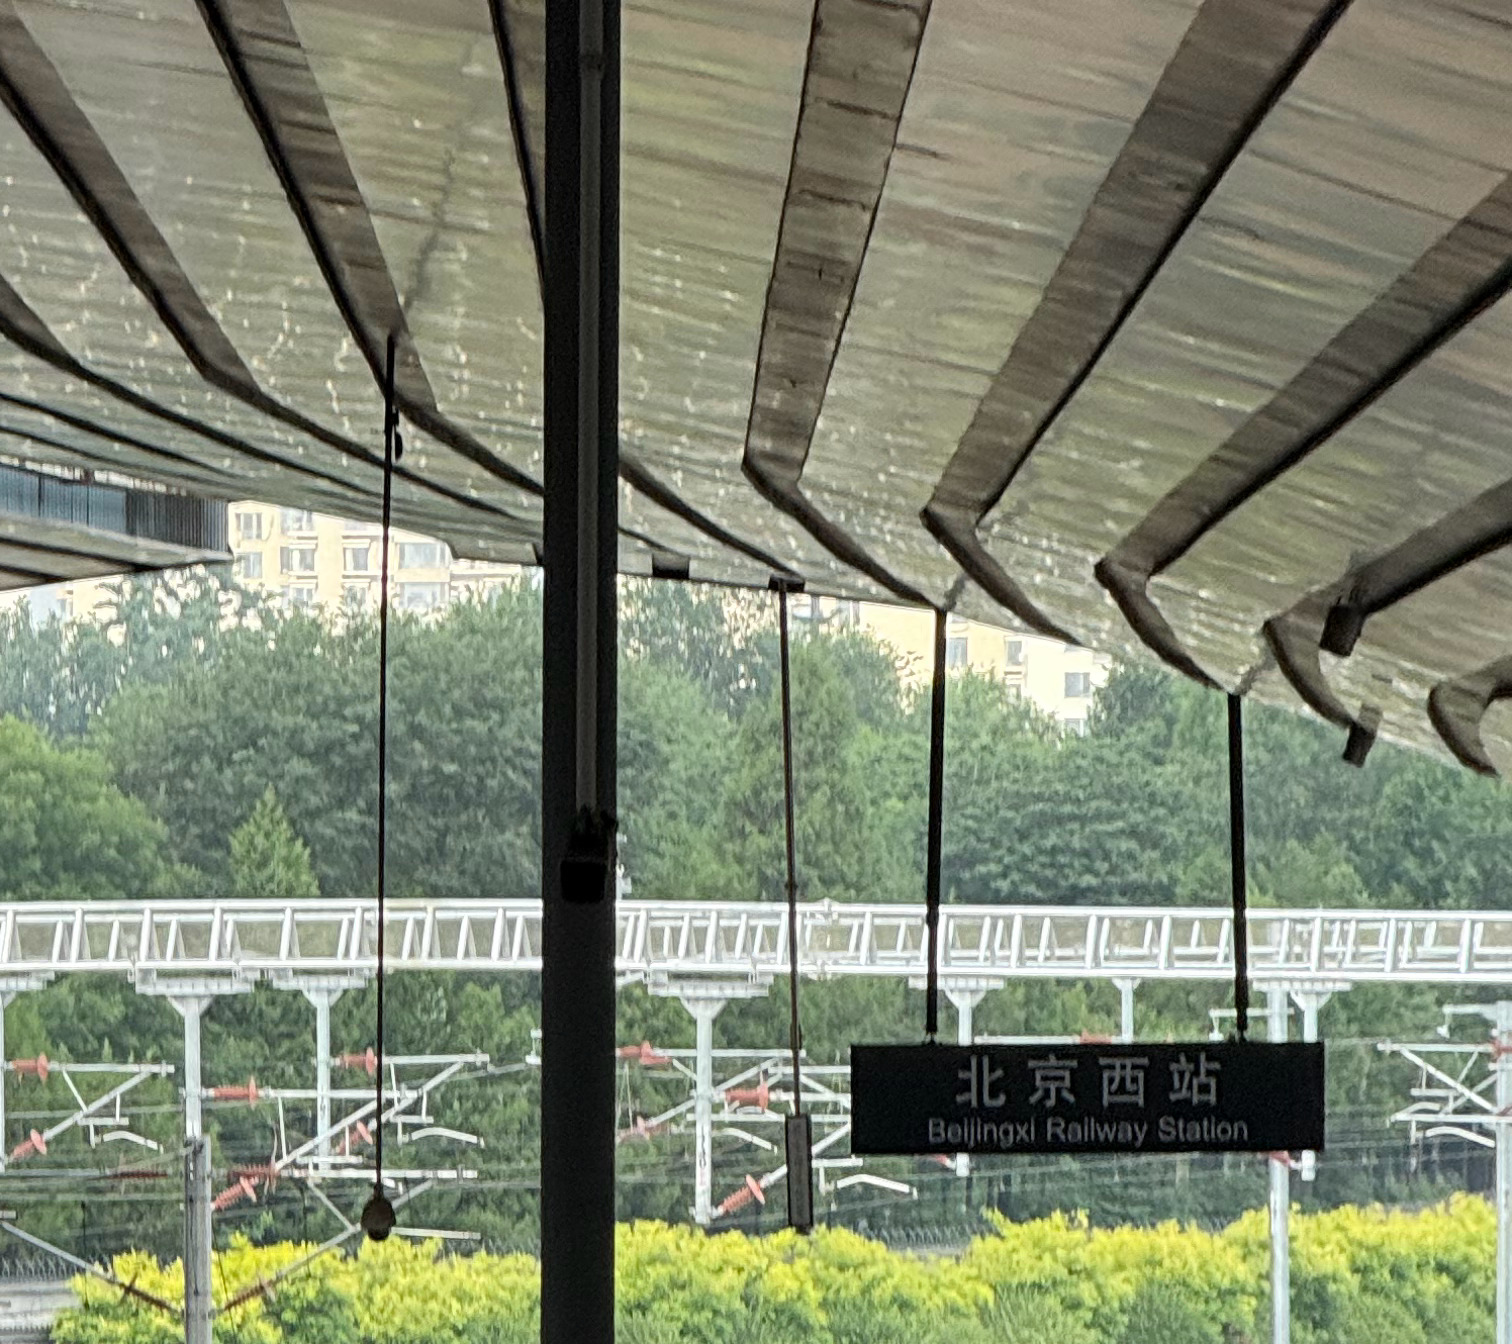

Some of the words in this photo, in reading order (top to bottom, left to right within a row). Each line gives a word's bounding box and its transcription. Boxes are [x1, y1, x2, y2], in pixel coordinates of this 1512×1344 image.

[955, 1052, 1223, 1109] 北京西站
[928, 1117, 1036, 1149] Beijingxi
[1046, 1115, 1148, 1149] Railway
[1157, 1114, 1249, 1144] Station
